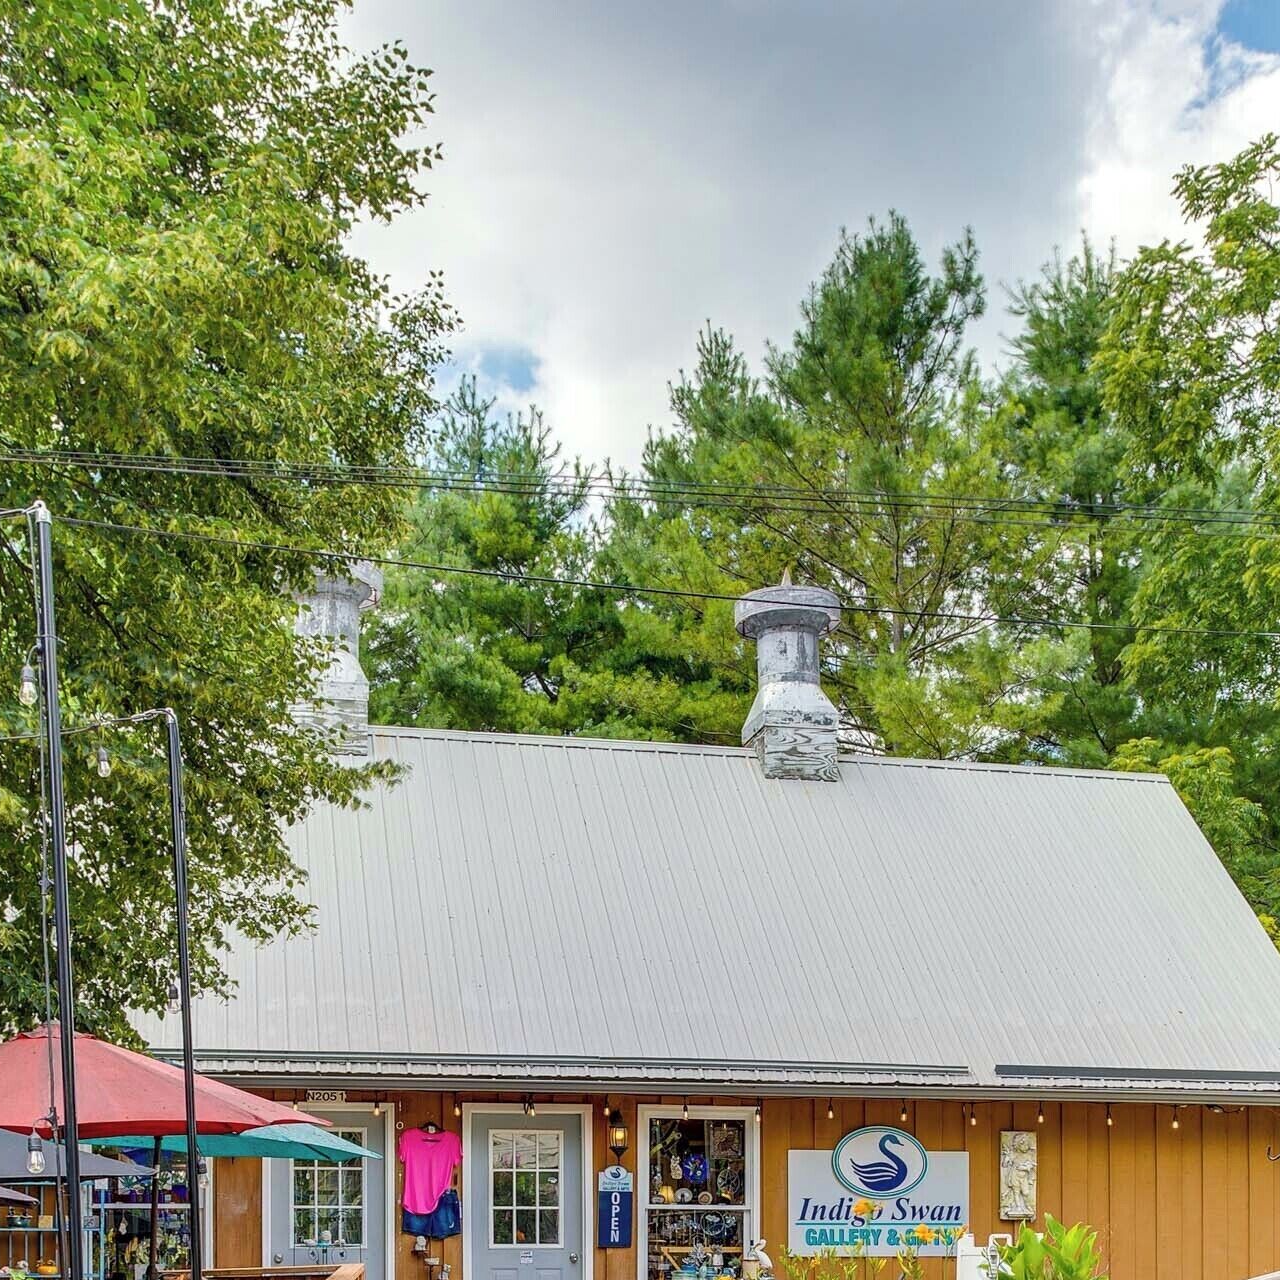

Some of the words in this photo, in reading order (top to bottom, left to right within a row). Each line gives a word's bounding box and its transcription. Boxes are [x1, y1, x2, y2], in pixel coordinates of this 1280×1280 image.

[307, 1091, 344, 1101] N2051
[610, 1192, 621, 1243] OPEN
[891, 1197, 961, 1221] Swan
[805, 1228, 882, 1246] GALLERY
[886, 1228, 901, 1246] &
